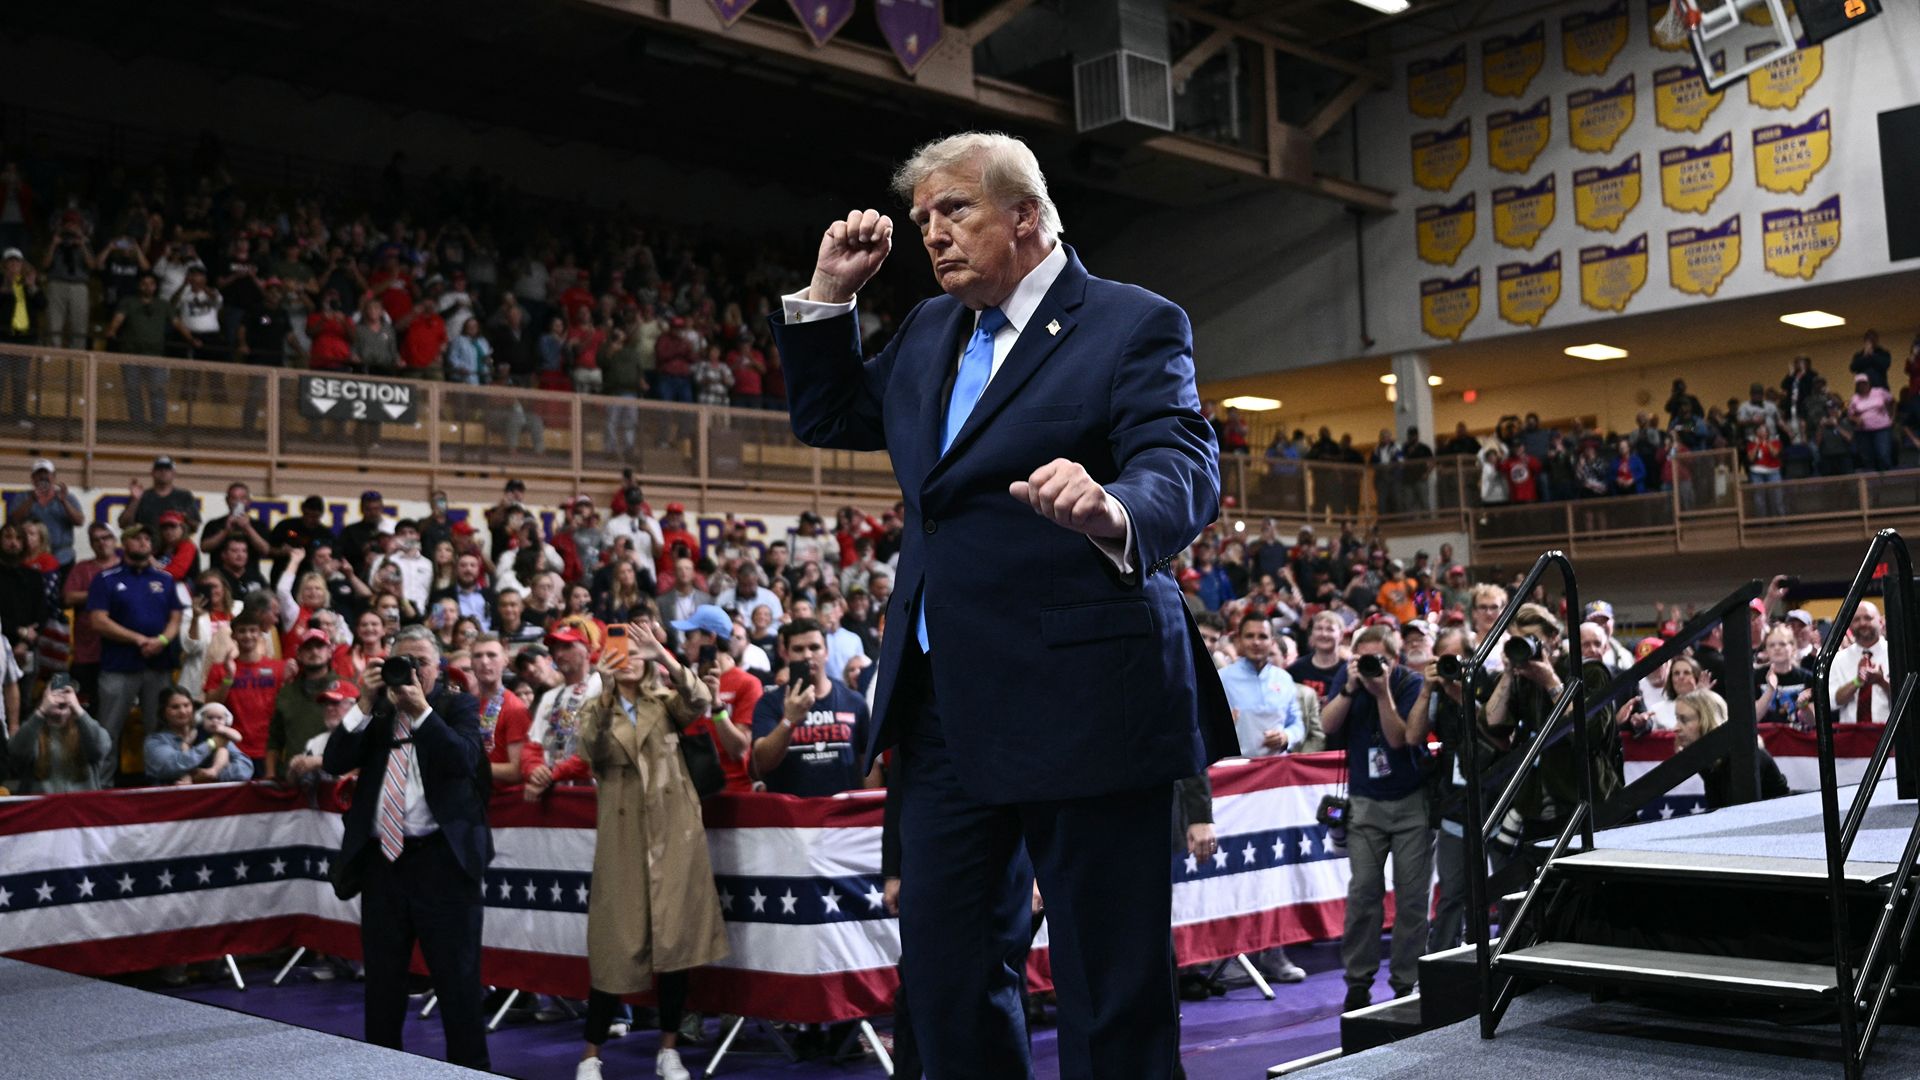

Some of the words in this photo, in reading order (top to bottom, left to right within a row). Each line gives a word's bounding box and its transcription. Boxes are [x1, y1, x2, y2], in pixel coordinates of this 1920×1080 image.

[1671, 80, 1703, 94] DANN
[1783, 226, 1817, 241] STATE
[1768, 236, 1835, 257] CHAMPIONS
[310, 378, 410, 403] SECTION
[352, 400, 367, 419] 2
[804, 710, 835, 726] JON
